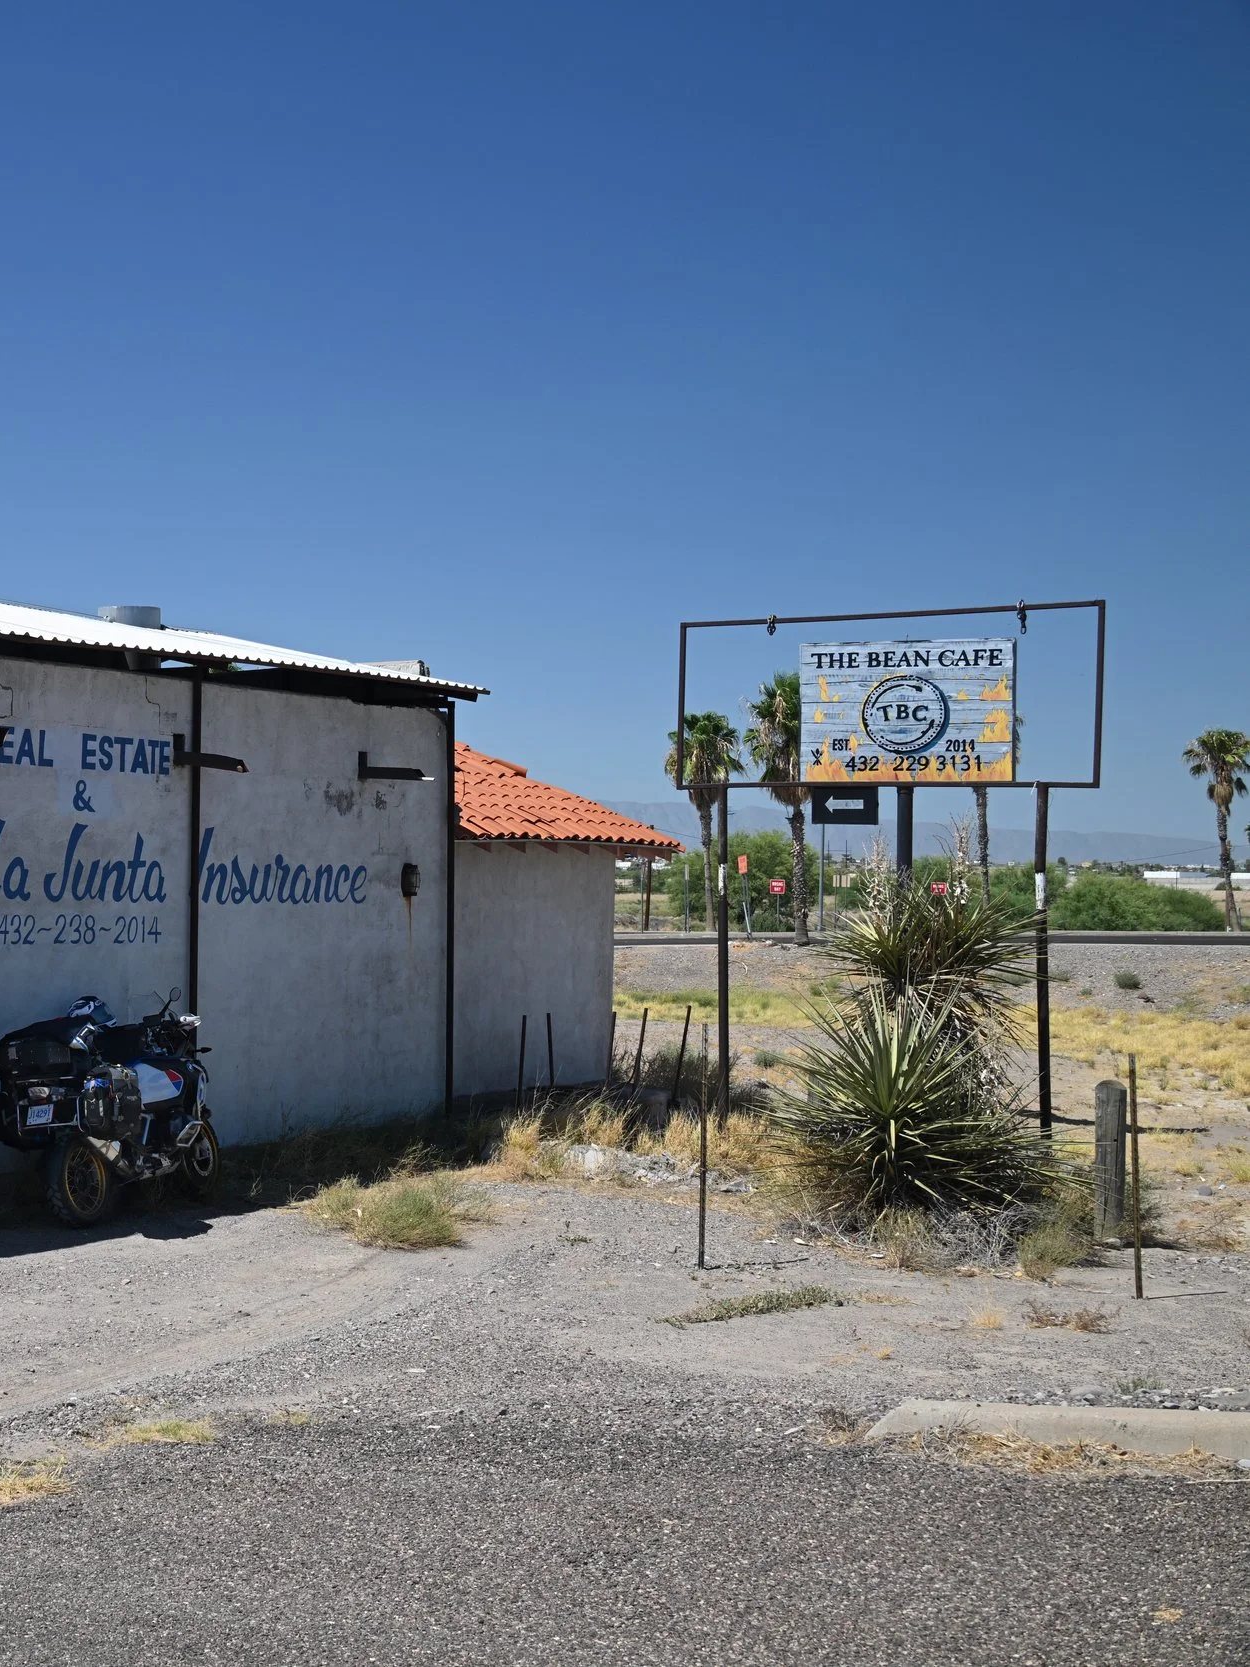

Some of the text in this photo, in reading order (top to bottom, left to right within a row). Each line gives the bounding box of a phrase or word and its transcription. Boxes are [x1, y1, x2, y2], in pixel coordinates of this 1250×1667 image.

[811, 648, 1003, 669] THE BEAN CAFE
[876, 704, 929, 722] TBC
[832, 738, 852, 751] EST.
[945, 739, 976, 752] 2014
[81, 733, 171, 776] ESTATE
[845, 754, 982, 772] 432 229 3131
[73, 779, 96, 813] &
[44, 822, 167, 904] Junta
[198, 826, 368, 905] Insurance
